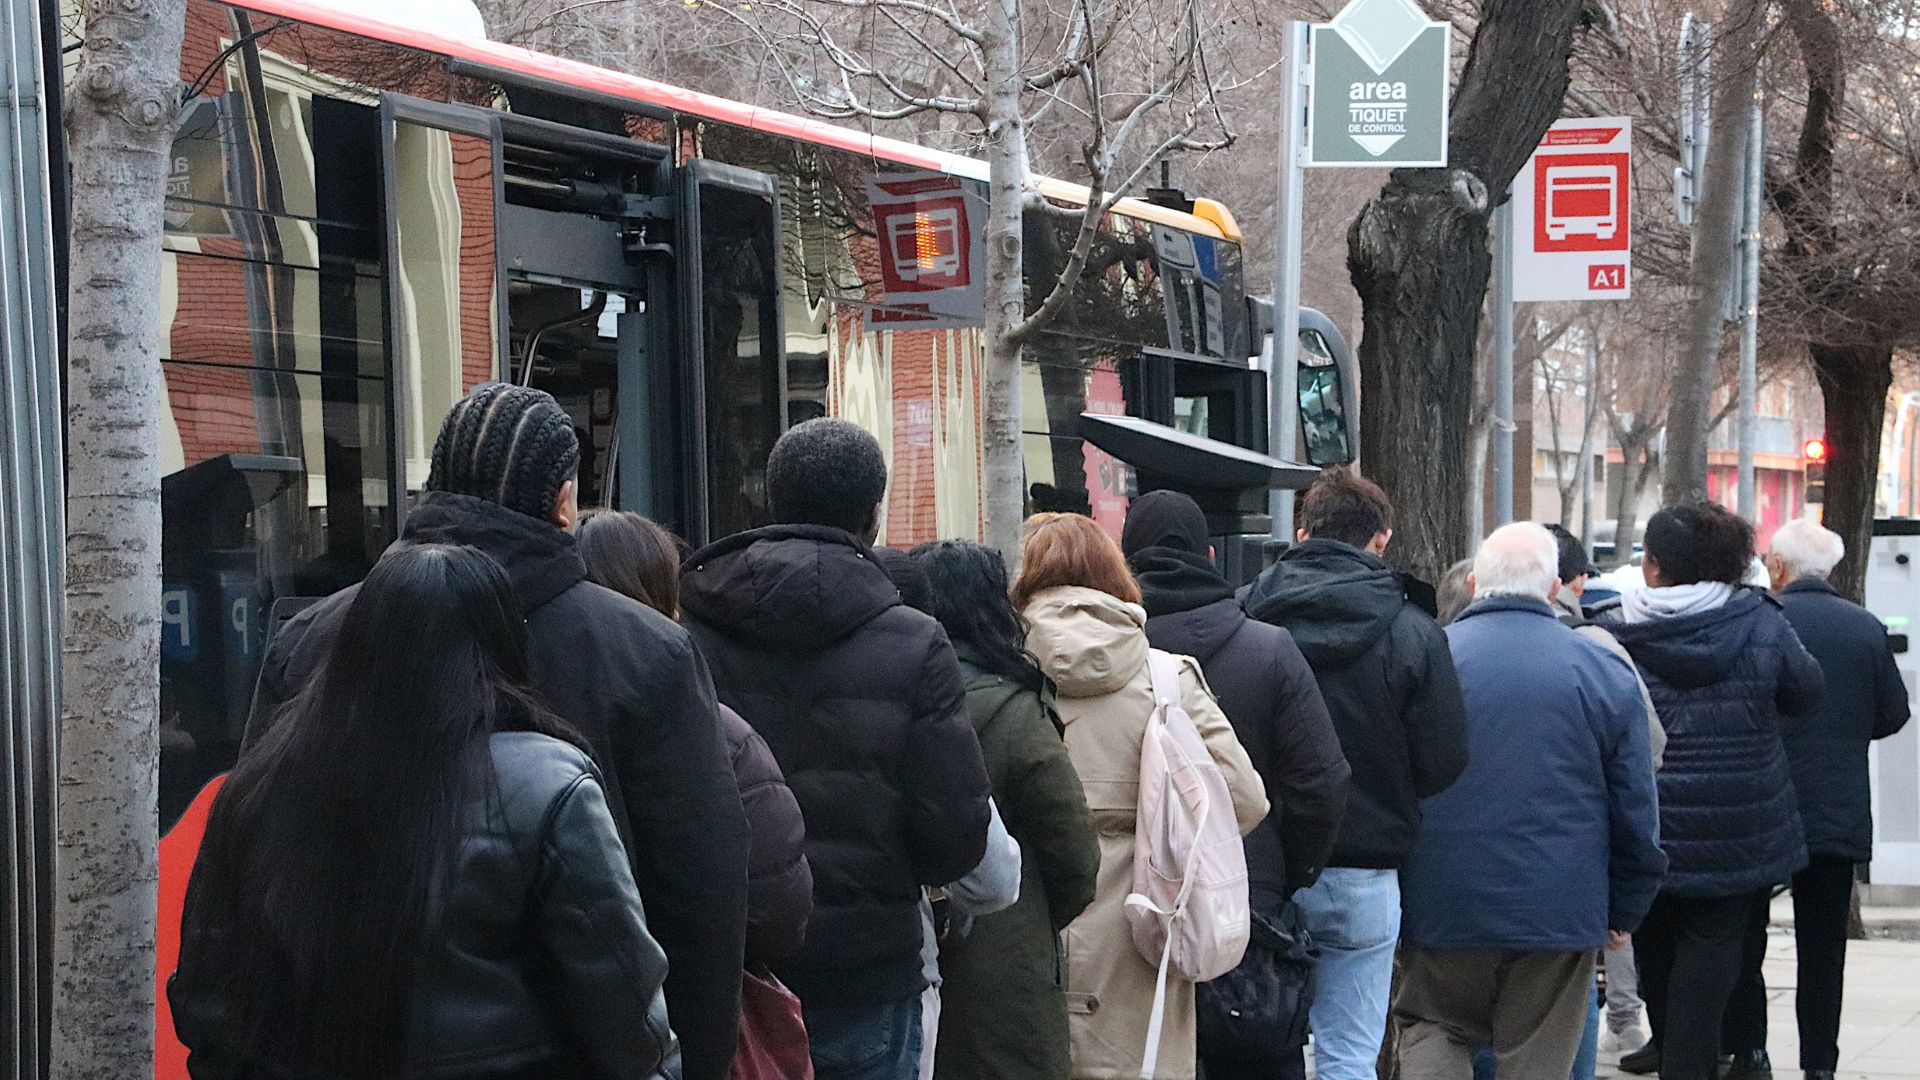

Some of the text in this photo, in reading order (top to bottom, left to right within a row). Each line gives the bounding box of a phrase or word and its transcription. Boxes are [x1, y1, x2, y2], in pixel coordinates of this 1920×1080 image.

[1350, 82, 1407, 100] area
[1349, 109, 1407, 122] TIQUET
[1348, 124, 1407, 133] DE CONTROL
[1593, 269, 1619, 287] A1
